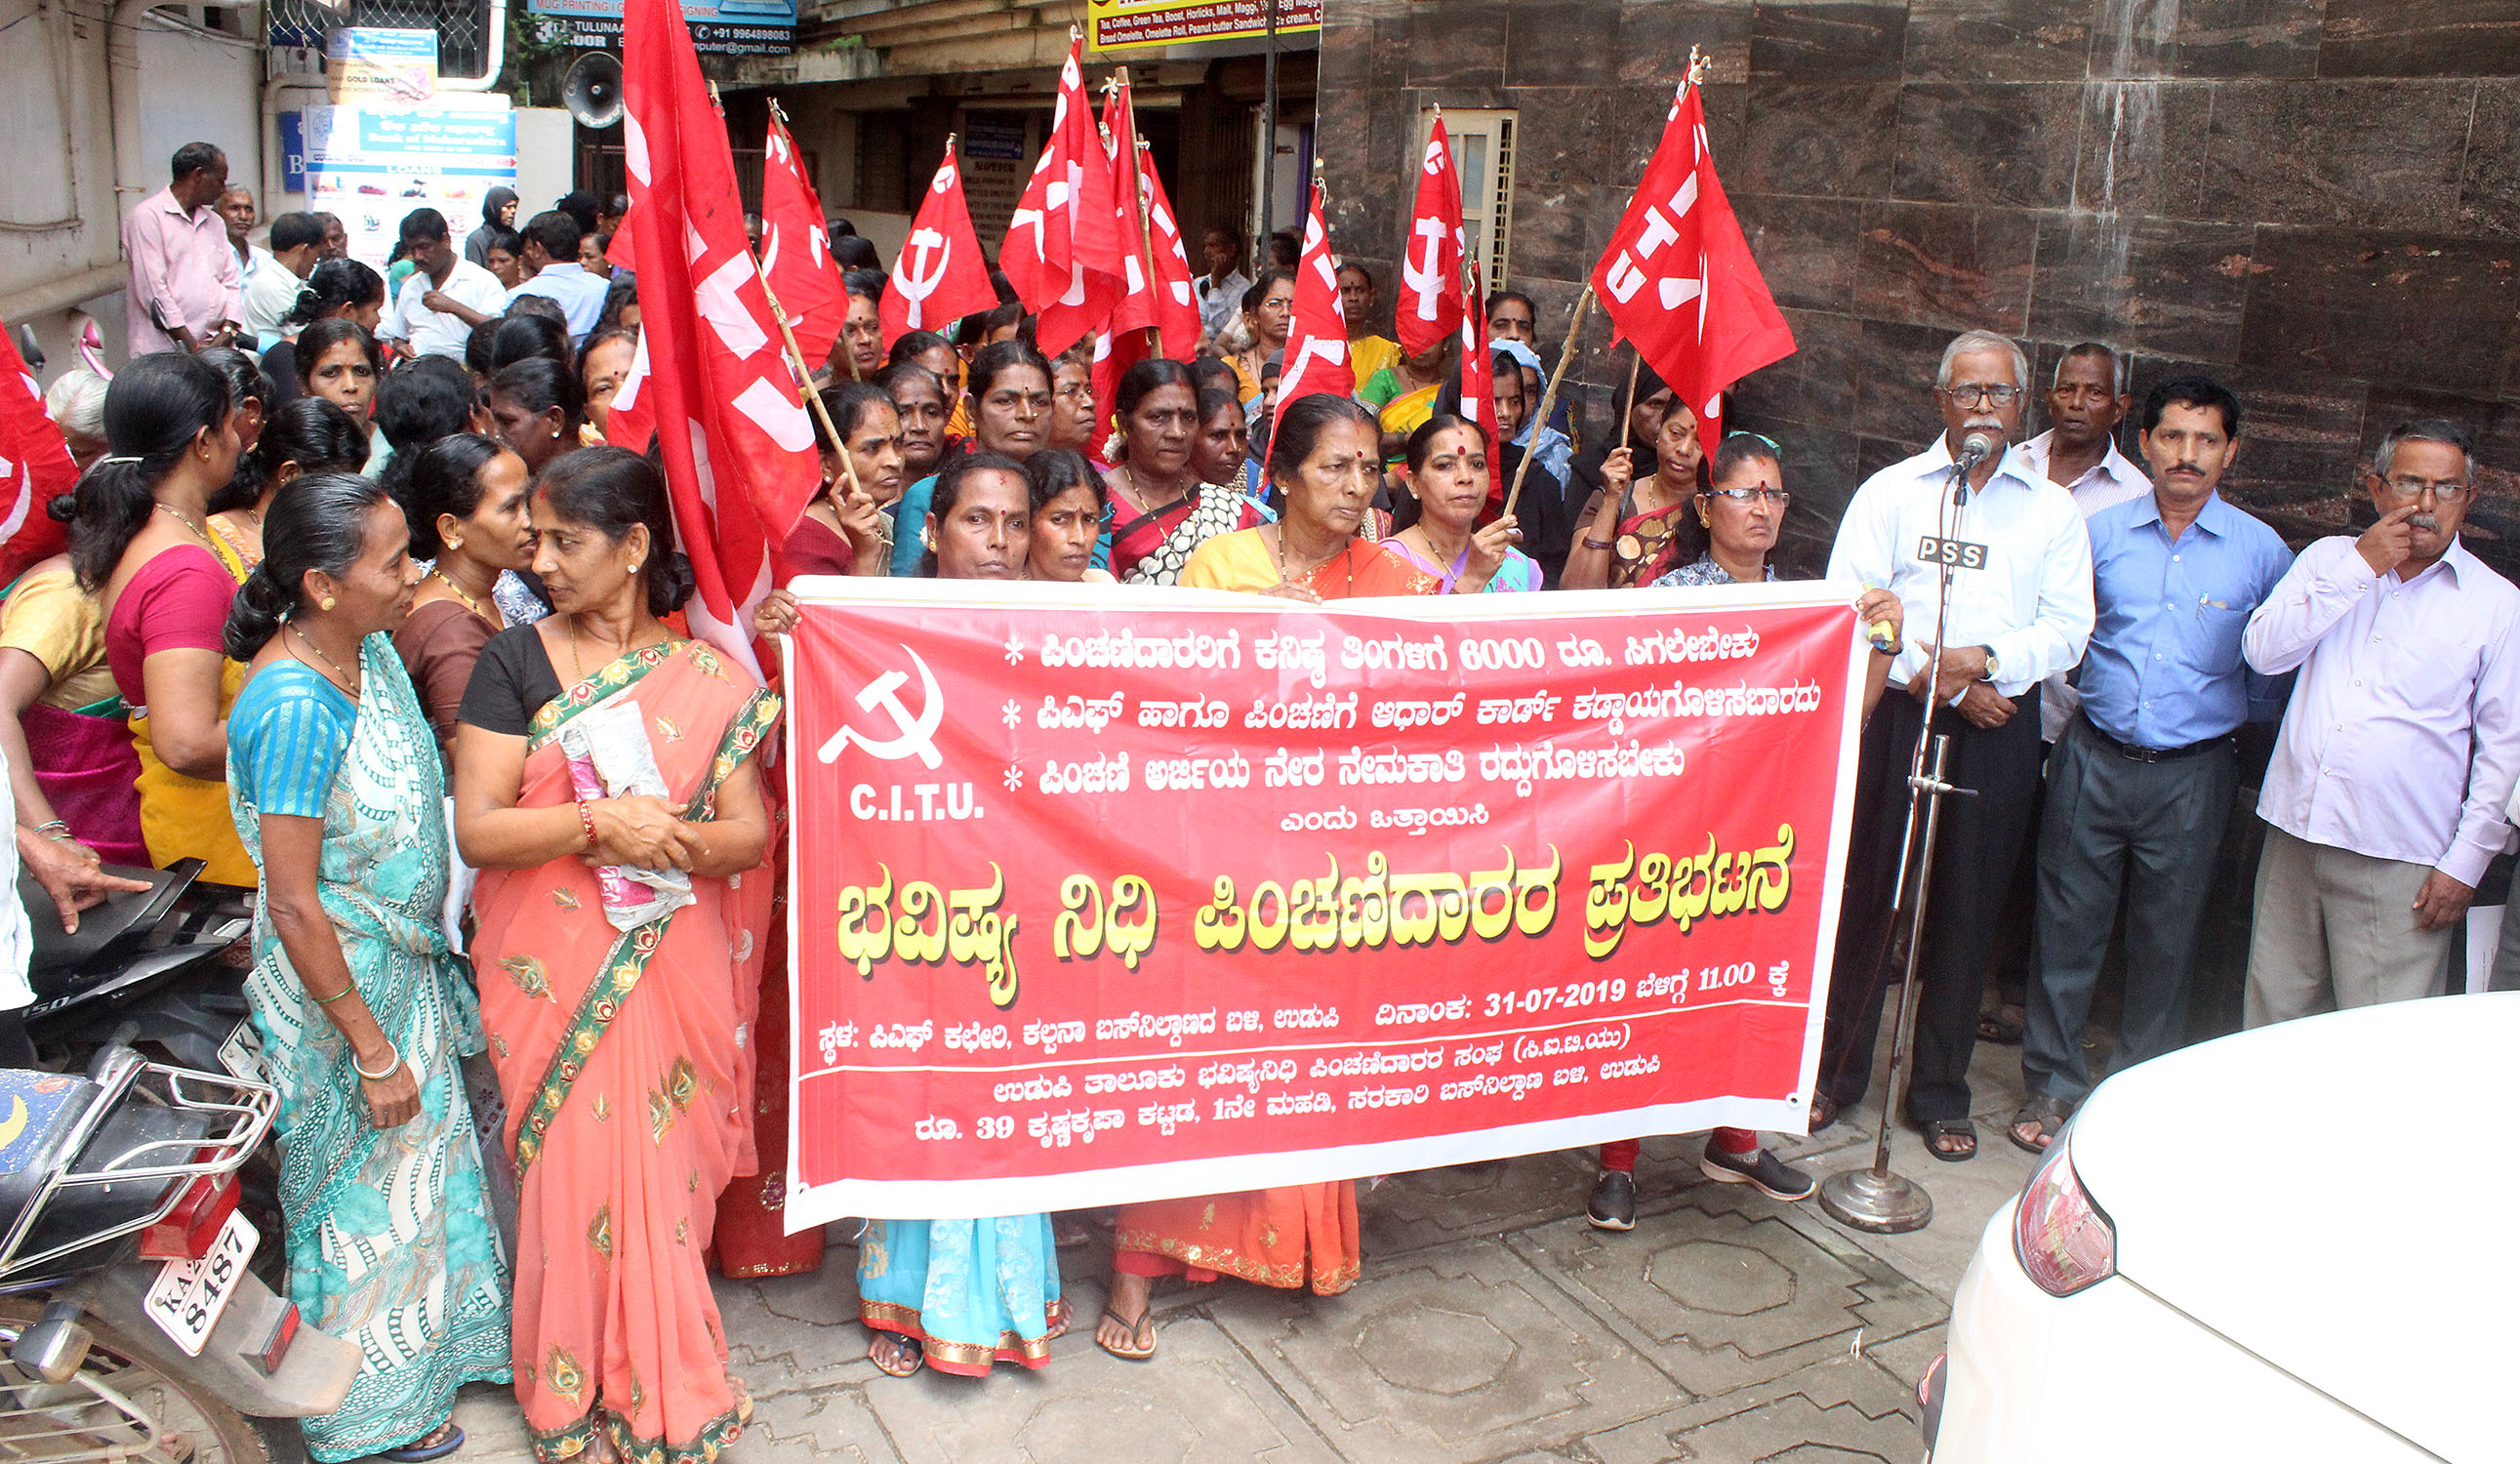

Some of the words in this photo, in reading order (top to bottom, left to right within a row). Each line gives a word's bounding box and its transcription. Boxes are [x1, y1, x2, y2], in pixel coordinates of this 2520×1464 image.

[562, 0, 608, 12] PRINTING
[712, 27, 730, 38] +91
[1919, 538, 1982, 567] PSS
[1040, 628, 1240, 669] ಪಿಂಚಣಿದಾರರಿಗೆ
[1340, 632, 1447, 671] ತಿಂಗಳಿಗೆ
[1459, 637, 1545, 671] 6000
[1557, 632, 1611, 667] ರೂ.
[1624, 625, 1759, 665] ಸಿಗಲೇಬೇಕು
[1036, 690, 1124, 735] ಪಿಎಫ್
[1138, 692, 1230, 729] ಹಾಗೂ
[1243, 691, 1358, 729] ಪಿಂಚಣಿಗೆ
[1371, 692, 1466, 731] ಆಧಾರ್
[1571, 677, 1820, 736] ಕಡ್ಡಾಯಗೊಳಿಸಬಾರದು
[1039, 751, 1129, 794] ಪಿಂಚಣಿ
[1145, 749, 1249, 792] ಅರ್ಜಿಯ
[1265, 746, 1324, 788] ನೇರ
[1338, 745, 1465, 786] ನೇಮಕಾತಿ
[1480, 739, 1685, 796] ರದ್ದುಗೊಳಿಸಬೇಕು
[850, 782, 984, 822] C.I.T.U.
[1280, 804, 1358, 832] ಎಂದು
[1370, 803, 1489, 835] ಒತ್ತಾಯಿಸಿ
[837, 861, 1019, 1007] ಭವಿಷ್ಯ
[1054, 874, 1159, 972] ನಿಧಿ
[1194, 842, 1561, 954] ಪಿಂಚಣಿದಾರರ
[1583, 823, 1795, 959] ಪ್ರತಿಭಟನೆ
[819, 1019, 859, 1065] ಸ್ಥಳ:
[870, 1019, 933, 1052] ಪಿಎಫ್
[945, 1021, 1012, 1053] ಕಛೇರಿ,
[1023, 1017, 1085, 1054] ಕಲ್ಪನಾ
[1226, 1008, 1264, 1033] ಬಳಿ,
[1274, 1002, 1339, 1029] ಉಡುಪಿ
[1375, 994, 1472, 1025] ದಿನಾಂಕ:
[1484, 978, 1626, 1017] 31-07-2019
[1636, 968, 1689, 1003] ಬೆಳಿಗ್ಗೆ
[1698, 961, 1755, 992] 11.00
[1768, 960, 1789, 996] ಕ್ಕೆ
[994, 1074, 1072, 1102] ಉಡುಪಿ
[1084, 1063, 1185, 1094] ತಾಲೂಕು
[1198, 1057, 1297, 1094] ಭವಿಷ್ಯನಿಧಿ
[1310, 1045, 1443, 1078] ಪಿಂಚಣಿದಾರರ
[1454, 1039, 1504, 1067] ಸಂಘ
[1514, 1023, 1630, 1063] (ಸಿ.ಐ.ಟಿ.ಯು)
[915, 1114, 963, 1140] ರೂ.
[976, 1116, 1015, 1139] 39
[1028, 1106, 1124, 1148] ಕೃಷ್ಣಕೃಪಾ
[1137, 1098, 1200, 1136] ಕಟ್ಟಡ,
[1212, 1094, 1255, 1120] 1ನೇ
[1267, 1088, 1336, 1116] ಮಹಡಿ,
[1348, 1083, 1429, 1110] ಸರಕಾರಿ
[1553, 1065, 1588, 1086] ಬಳಿ,
[1601, 1054, 1660, 1080] ಉಡುಪಿ
[185, 1227, 243, 1334] 8487
